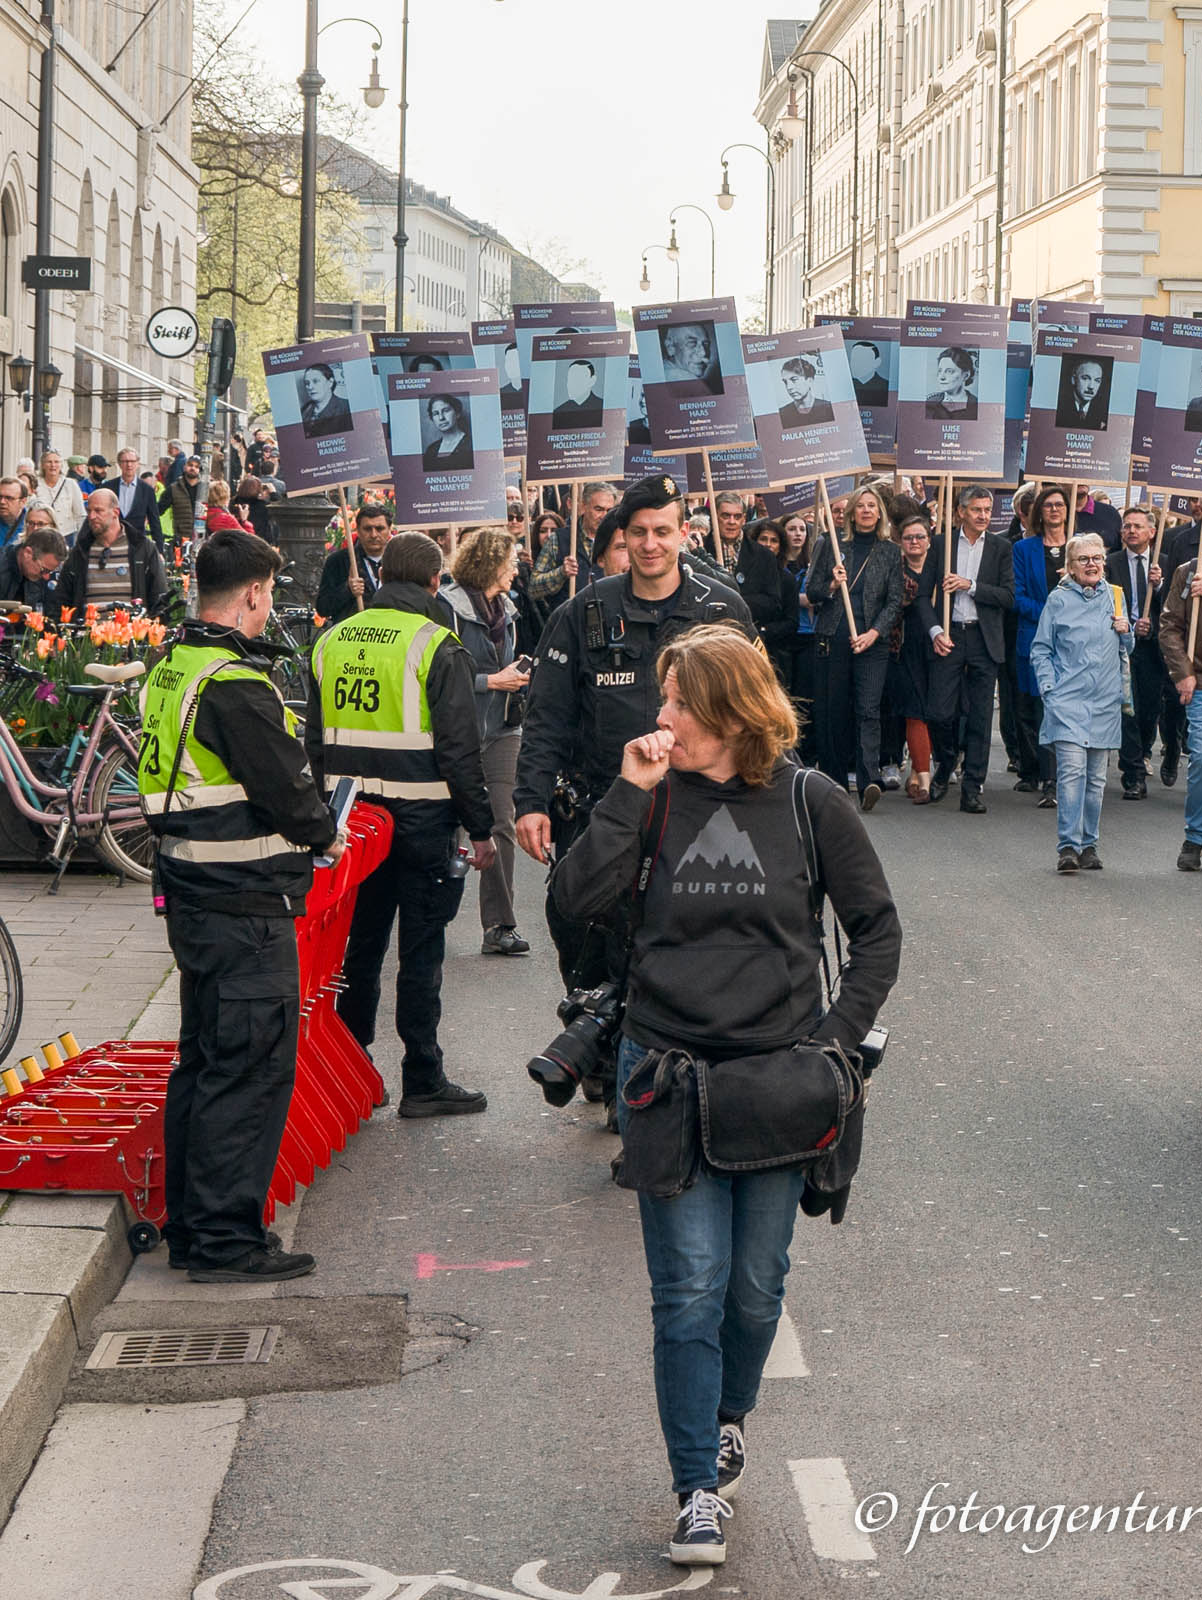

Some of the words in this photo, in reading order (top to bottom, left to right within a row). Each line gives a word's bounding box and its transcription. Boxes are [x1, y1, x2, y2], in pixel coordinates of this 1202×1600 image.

[38, 268, 79, 278] ODEEH
[152, 325, 193, 340] Steiff
[1172, 328, 1183, 336] DER
[680, 401, 717, 411] BERNHARD
[690, 409, 709, 417] HAAS
[942, 425, 961, 433] LUISE
[547, 434, 581, 443] FRIEDRICH
[782, 432, 803, 441] PAULA
[804, 437, 821, 446] WEIL
[944, 432, 959, 441] FREI
[1066, 433, 1094, 442] EDUARD
[317, 437, 347, 449] HEDWIG
[1067, 441, 1092, 450] HAMM
[319, 446, 347, 457] RAILING
[426, 477, 447, 485] ANNA
[449, 475, 473, 483] LOUISE
[1171, 471, 1194, 479] Ermordet
[430, 483, 470, 493] NEUMEYER
[1178, 498, 1187, 510] BR
[338, 626, 402, 645] SICHERHEIT
[358, 648, 366, 660] &
[342, 662, 375, 676] Service
[596, 671, 635, 687] POLIZEI
[334, 676, 380, 713] 643
[638, 869, 650, 891] EOS
[672, 882, 766, 895] BURTON
